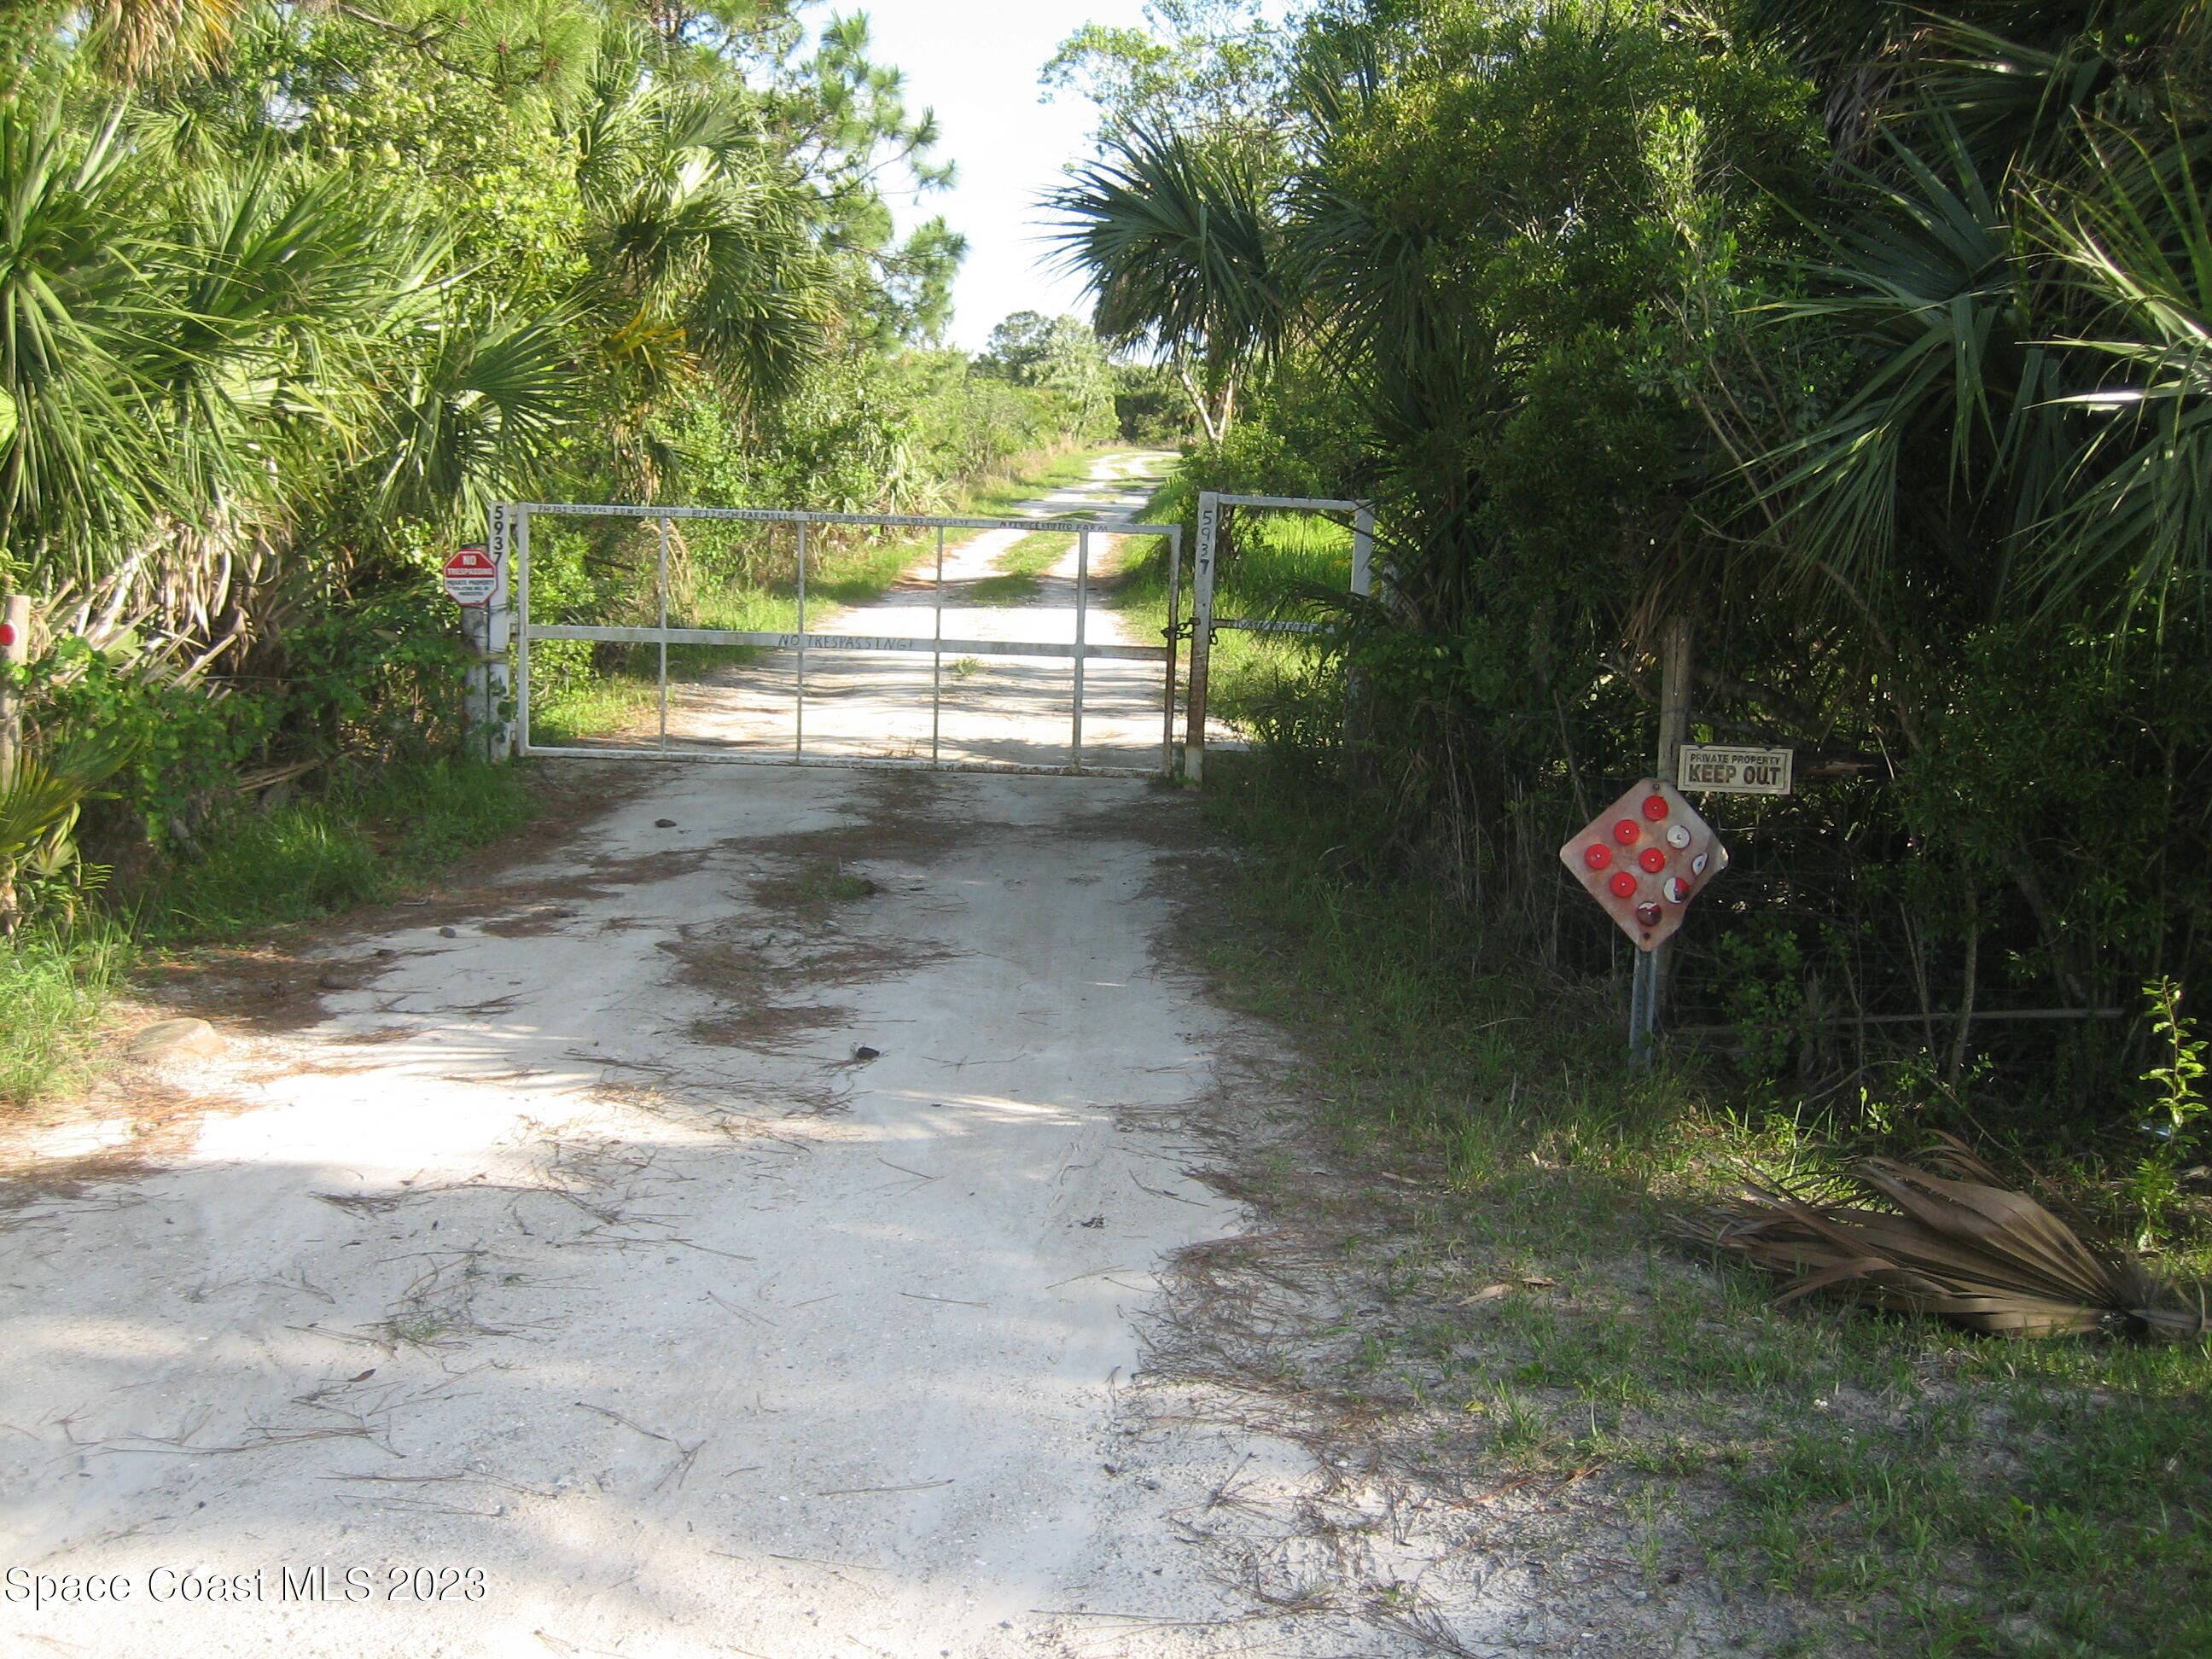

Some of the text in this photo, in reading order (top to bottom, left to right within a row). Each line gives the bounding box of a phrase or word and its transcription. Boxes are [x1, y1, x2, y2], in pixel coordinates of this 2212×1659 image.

[493, 505, 504, 564] 5937
[1075, 523, 1108, 532] FARM
[1199, 510, 1214, 575] 5937
[777, 633, 915, 650] NO TRESPASSING!
[1690, 753, 1782, 765] PRIVATE PROPERTY
[1688, 764, 1782, 785] KEEP OUT
